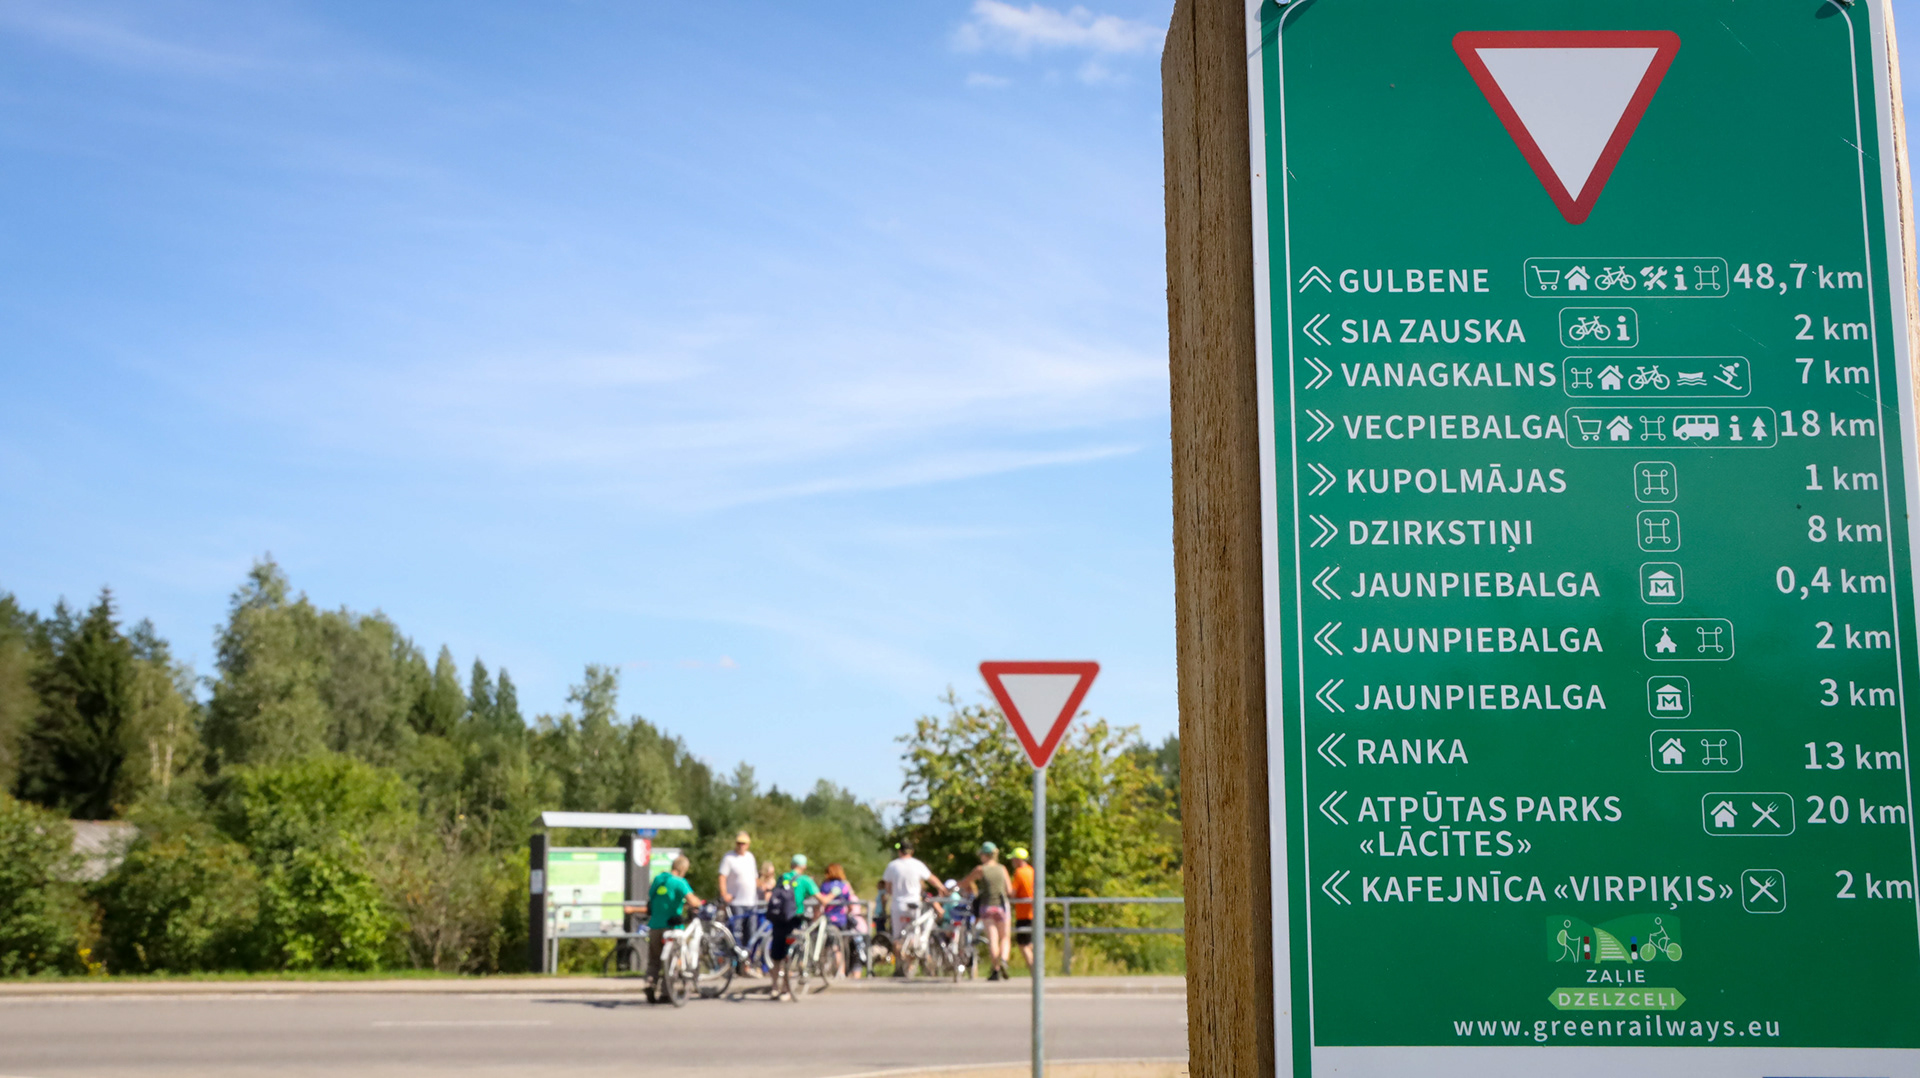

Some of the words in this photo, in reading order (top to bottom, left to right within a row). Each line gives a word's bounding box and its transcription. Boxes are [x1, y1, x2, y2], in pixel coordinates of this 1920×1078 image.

[1339, 268, 1490, 293] GULBENE
[1733, 262, 1808, 296] 48,7
[1816, 264, 1865, 290] km
[1341, 318, 1393, 344] SIA
[1399, 318, 1526, 344] ZAUSKA
[1794, 313, 1815, 341] 2
[1822, 313, 1869, 341] km
[1340, 362, 1557, 388] VANAGKALNS
[1795, 357, 1814, 384] 7
[1824, 359, 1870, 384] km
[1342, 414, 1564, 440] VECPIEBALGA
[1780, 409, 1821, 437] 18
[1830, 410, 1877, 437] km
[1347, 463, 1567, 494] KUPOLMĀJAS
[1805, 463, 1823, 491] 1
[1832, 462, 1880, 491] km
[1349, 519, 1533, 553] DZIRKSTIŅI
[1807, 514, 1827, 543] 8
[1836, 517, 1883, 542] km
[1350, 571, 1601, 598] JAUNPIEBALGA
[1775, 565, 1832, 601] 0,4
[1840, 568, 1889, 594] km
[1352, 627, 1604, 654] JAUNPIEBALGA
[1815, 620, 1836, 649] 2
[1845, 623, 1891, 649] km
[1354, 684, 1607, 711] JAUNPIEBALGA
[1819, 678, 1839, 707] 3
[1849, 681, 1897, 706] km
[1357, 738, 1469, 765] RANKA
[1804, 741, 1845, 770] 13
[1855, 743, 1903, 770] km
[1357, 790, 1507, 823] ATPŪTAS
[1516, 795, 1622, 822] PARKS
[1806, 795, 1849, 824] 20
[1859, 798, 1907, 824] km
[1362, 870, 1547, 903] KAFEJNĪCA
[1835, 869, 1856, 899] 2
[1865, 871, 1913, 899] km
[1585, 968, 1647, 988] ZAĻIE
[1558, 992, 1676, 1010] DZELZCEĻI
[1453, 1014, 1780, 1042] www.greenrailways.eu
